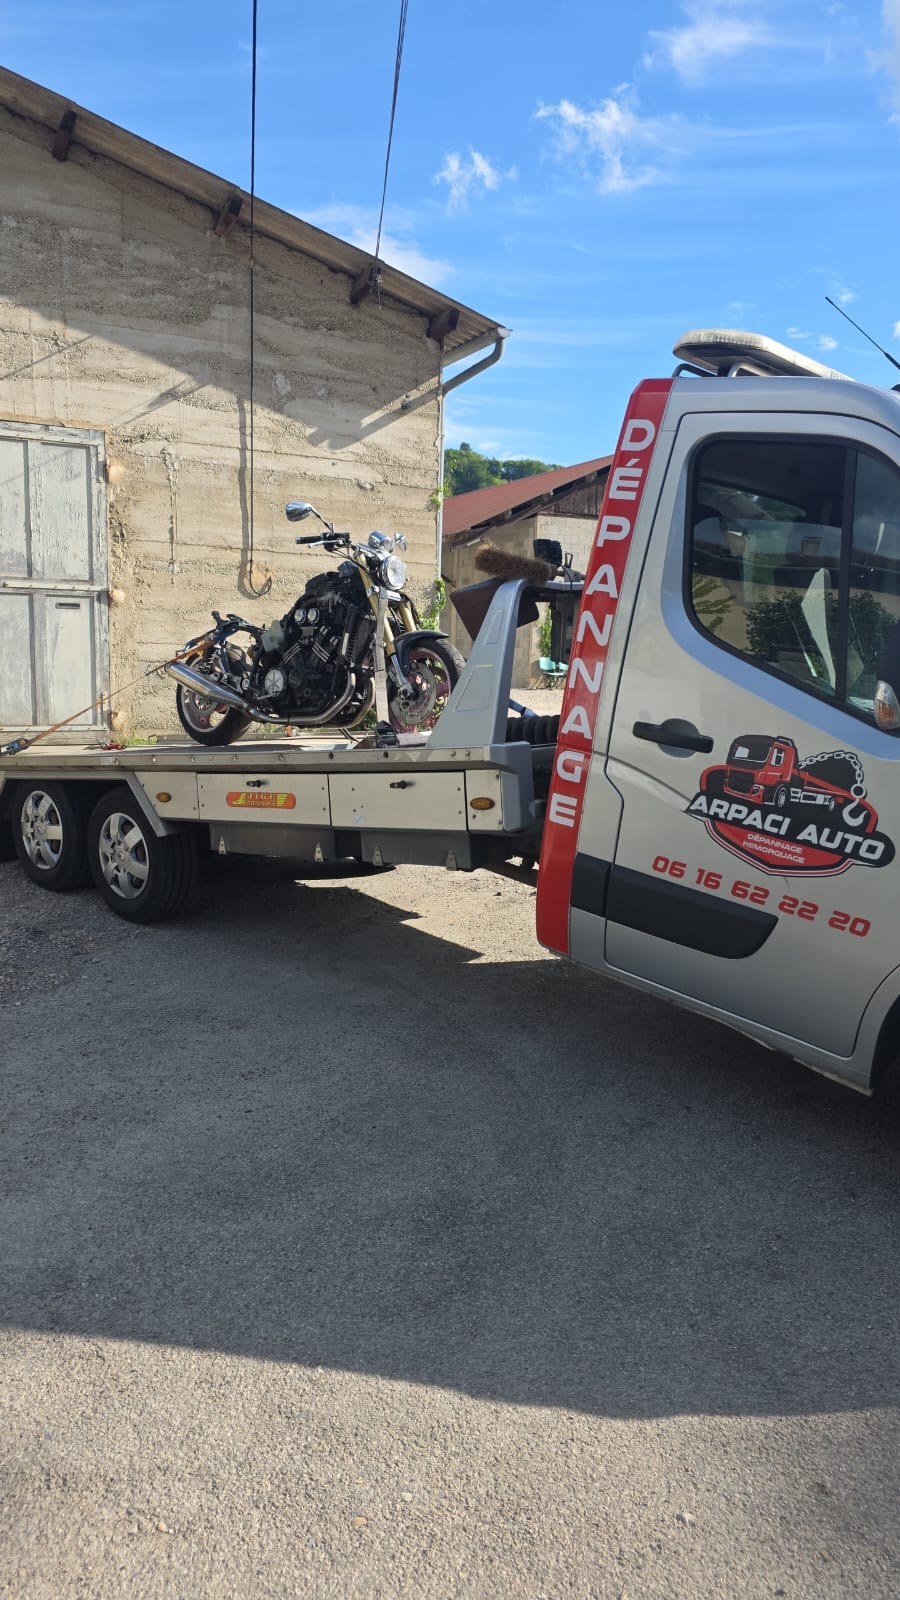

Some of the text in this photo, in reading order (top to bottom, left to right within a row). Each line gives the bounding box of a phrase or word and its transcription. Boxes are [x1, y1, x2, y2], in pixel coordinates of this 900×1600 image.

[549, 418, 656, 828] DÉPANNAGE
[689, 795, 885, 861] ARPACI AUTO
[742, 840, 805, 864] REMORQUAGE
[747, 833, 803, 854] DÉPANNAGE
[652, 855, 871, 938] 06 16 62 22 20
